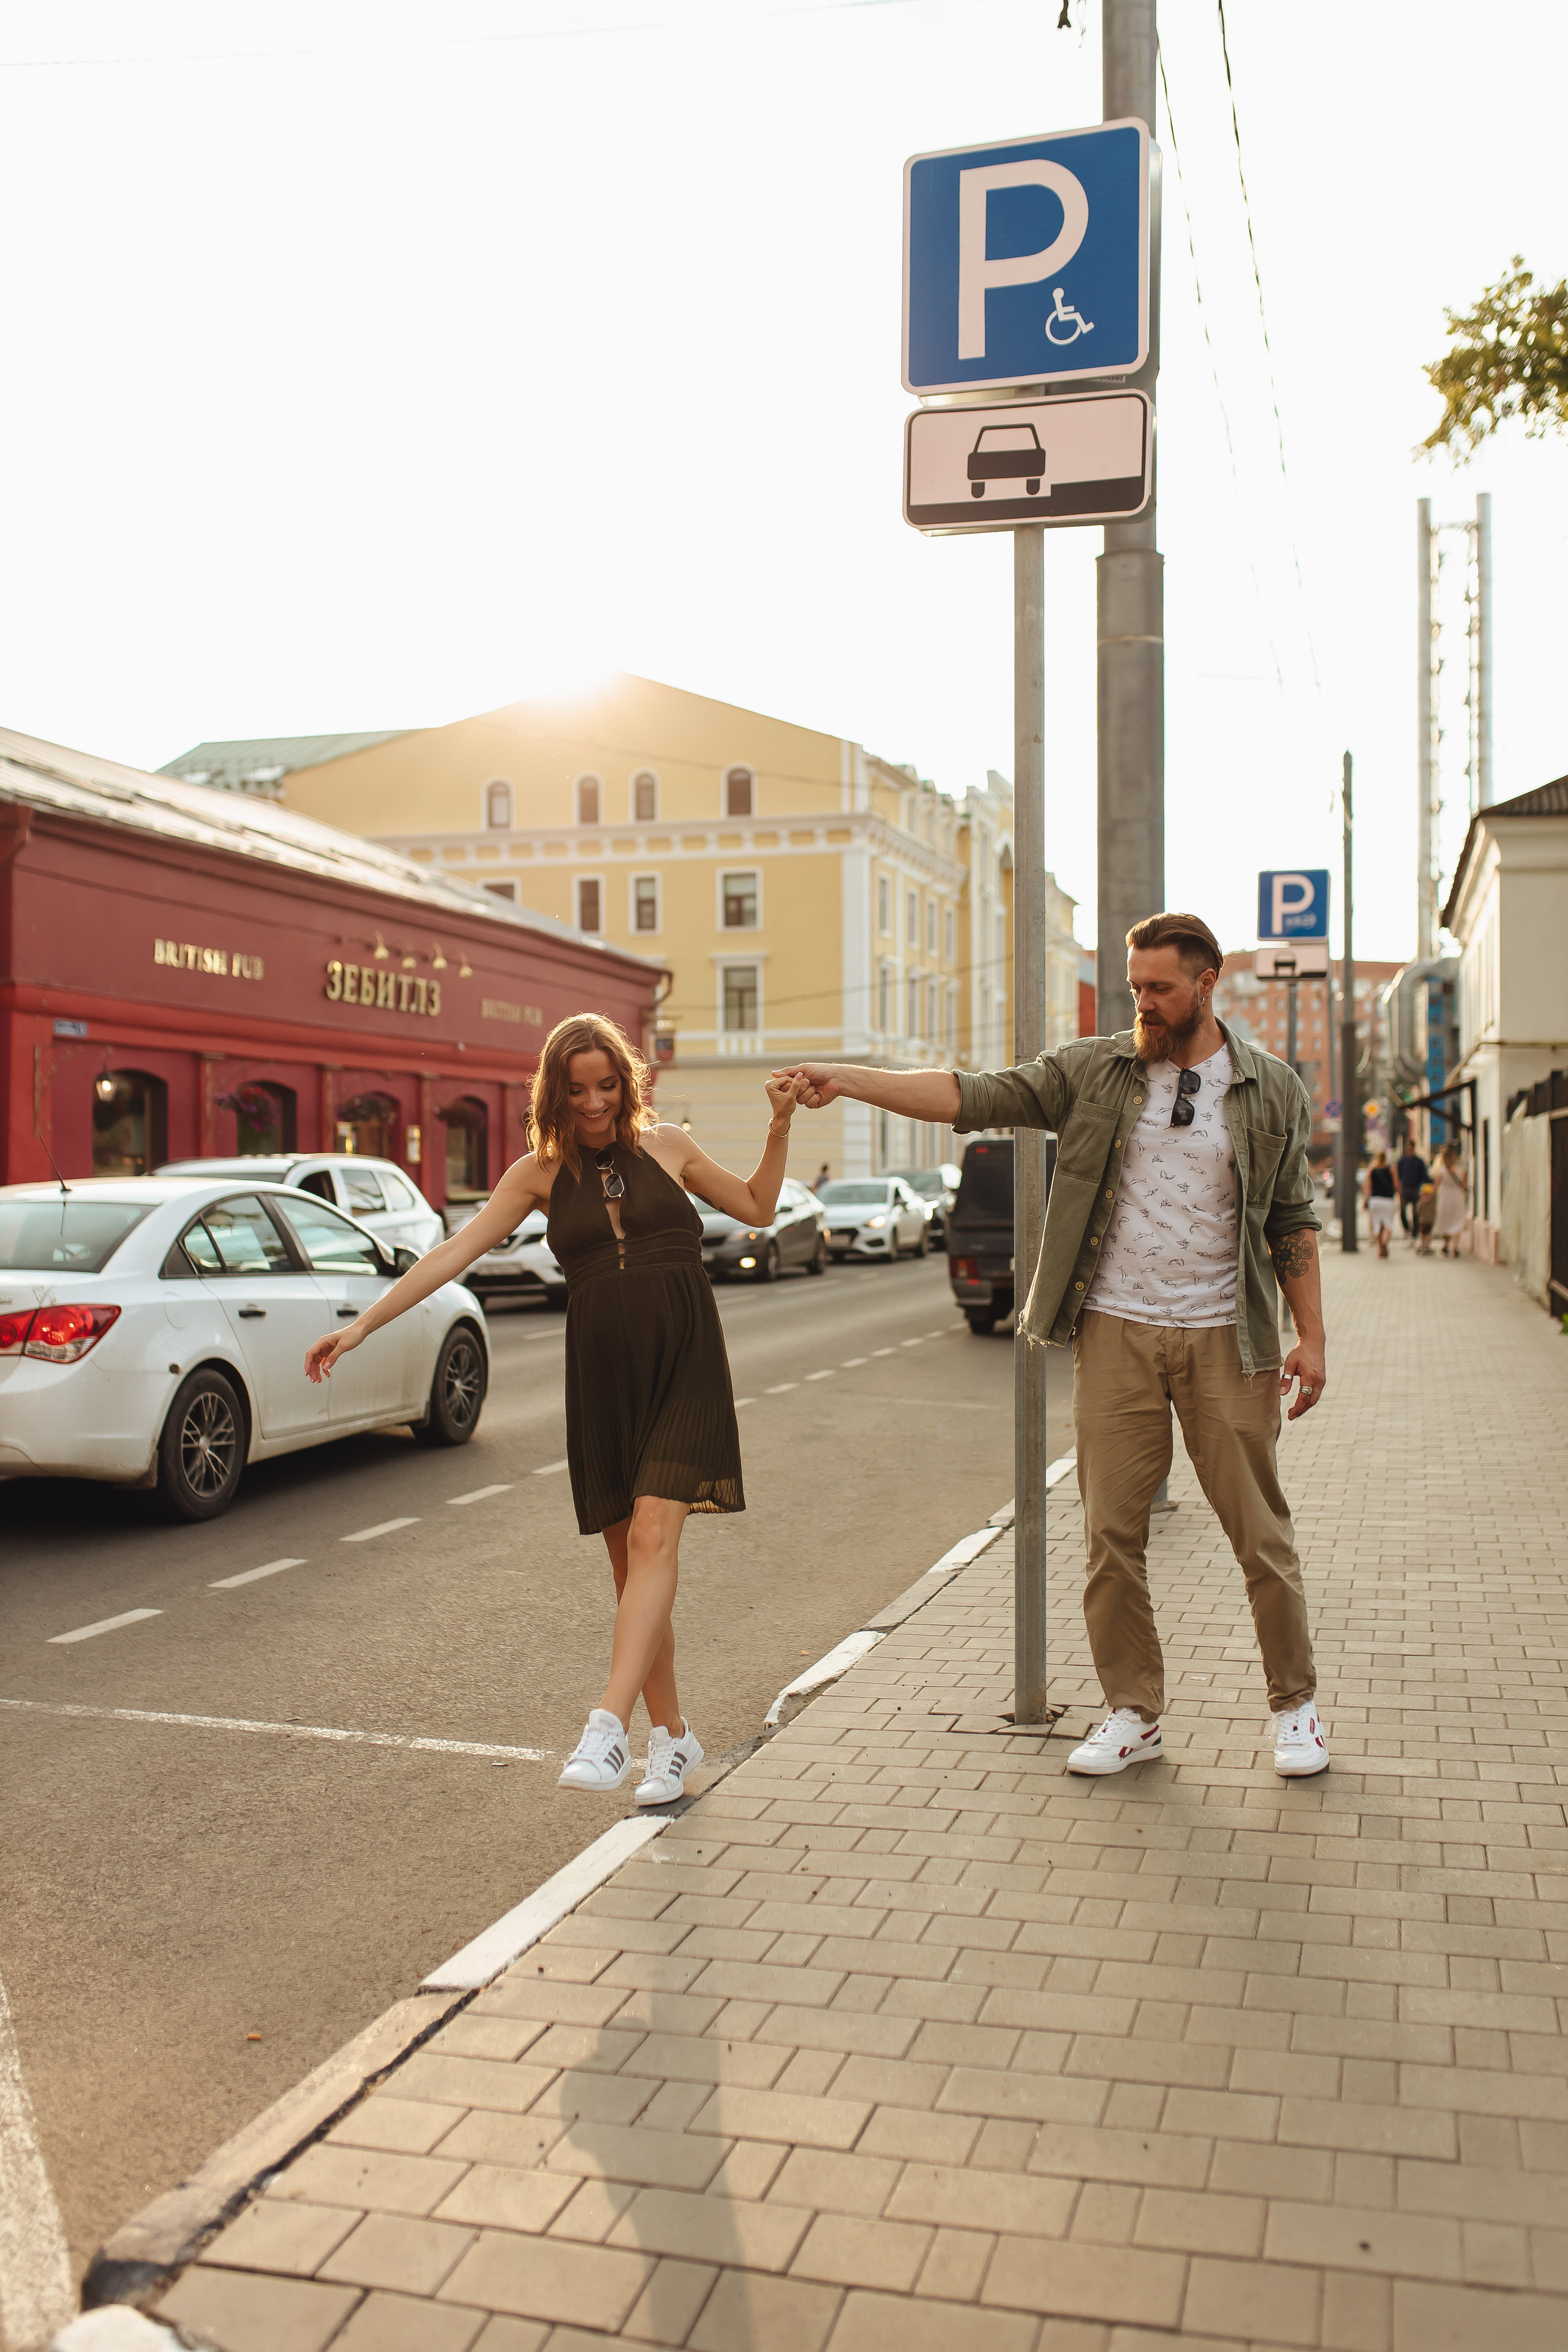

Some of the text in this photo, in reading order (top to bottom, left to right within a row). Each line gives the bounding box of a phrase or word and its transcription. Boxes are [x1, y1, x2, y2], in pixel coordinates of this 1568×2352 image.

[958, 159, 1089, 360] P
[1272, 873, 1316, 936] P
[154, 938, 265, 981] BRITISH PUB
[325, 960, 441, 1017] ЗЕБИТЛЗ
